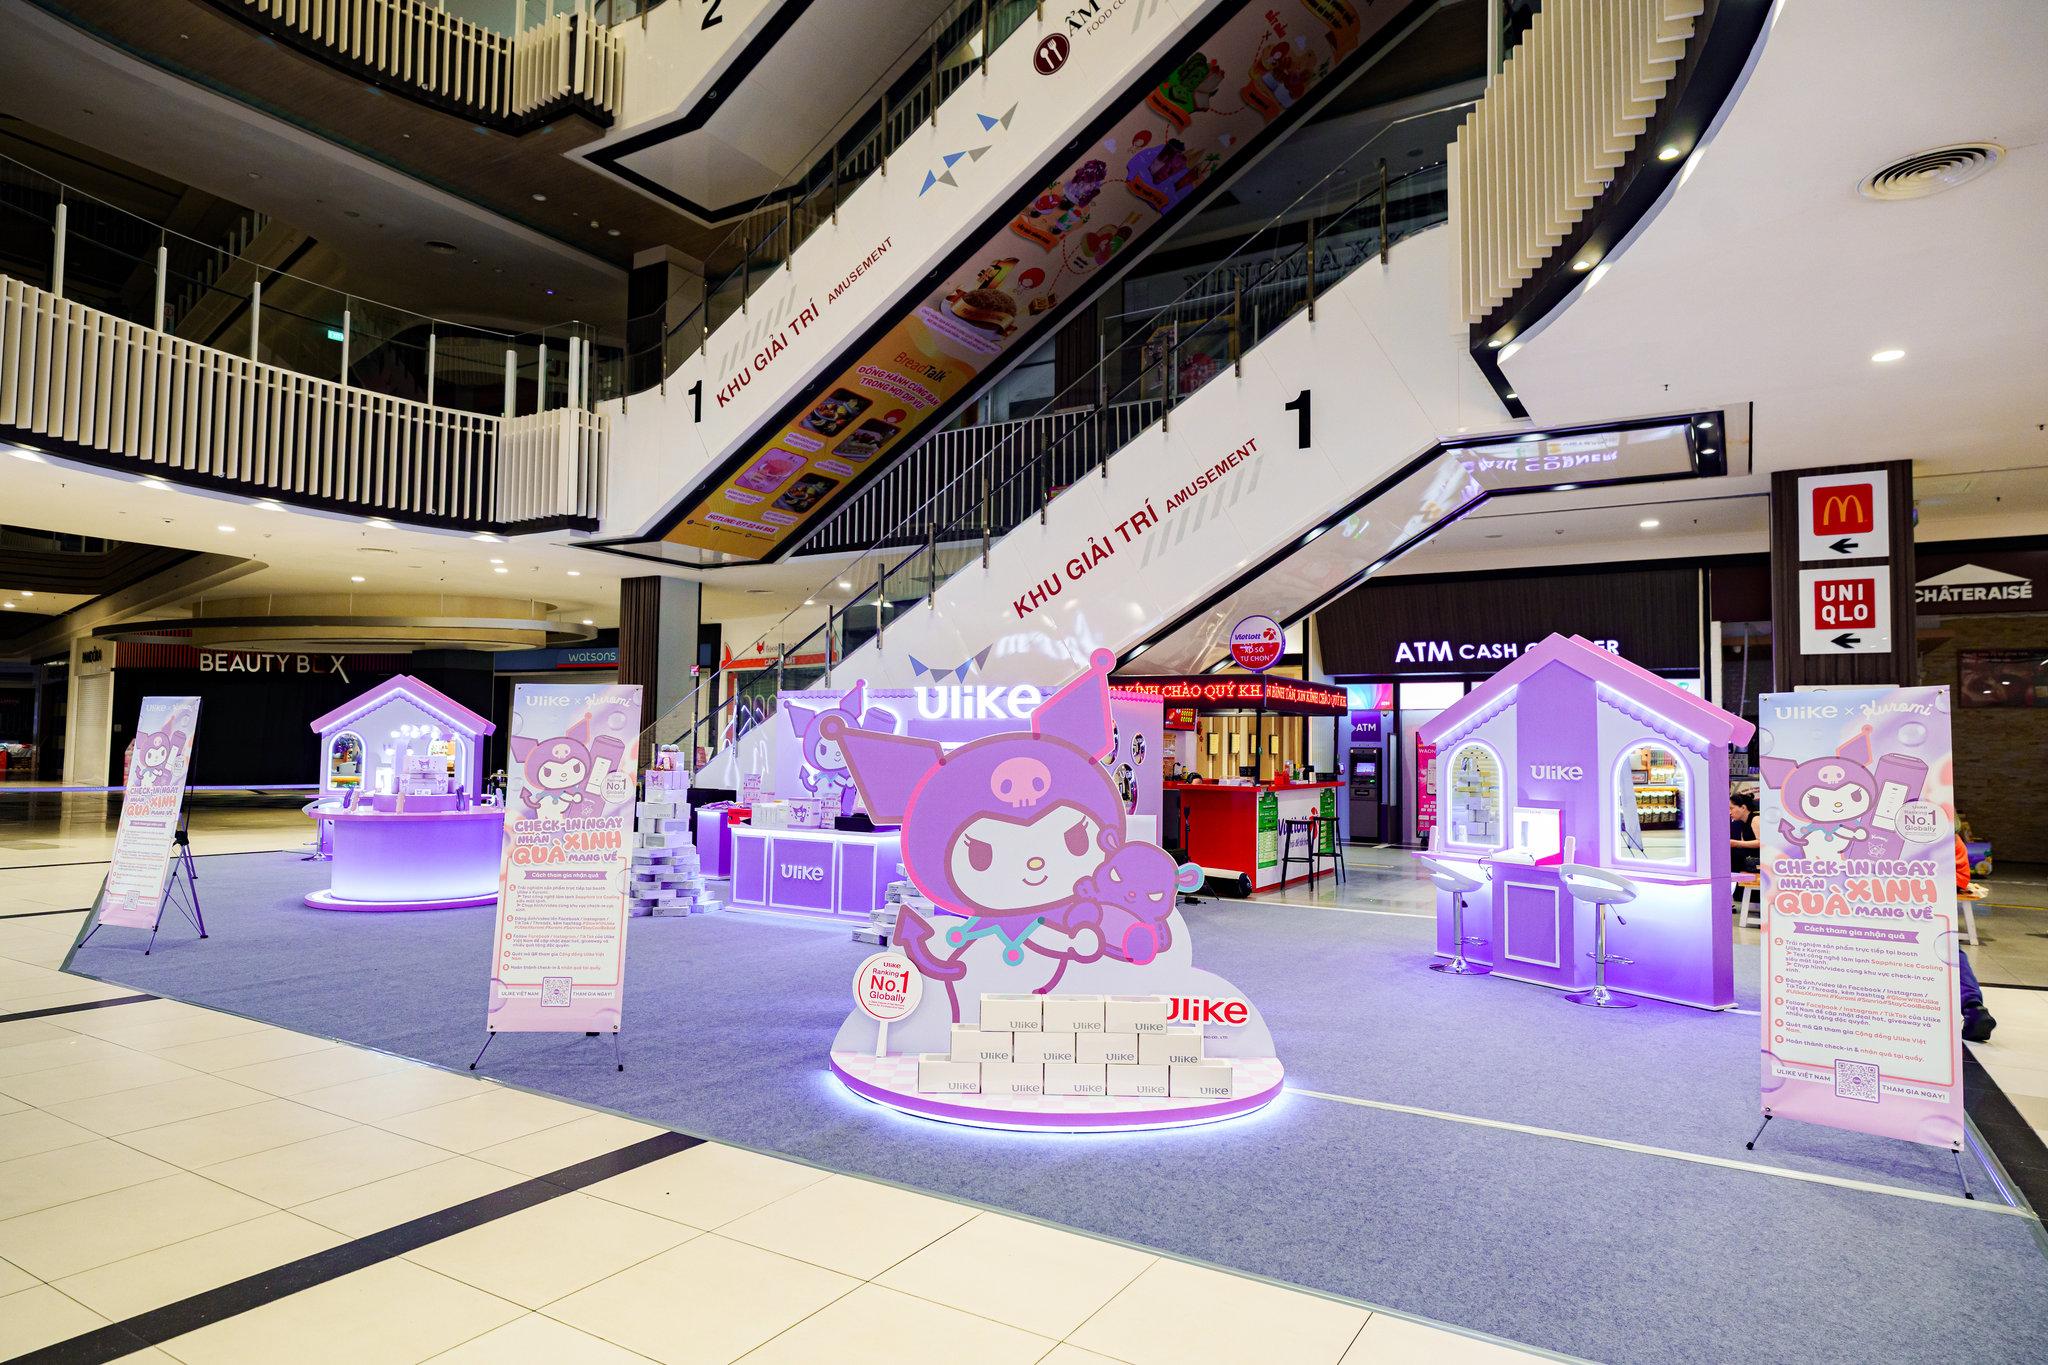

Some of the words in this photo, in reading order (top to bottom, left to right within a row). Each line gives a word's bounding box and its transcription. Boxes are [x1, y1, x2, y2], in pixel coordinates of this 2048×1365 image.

[1087, 9, 1114, 36] FOOD
[716, 367, 751, 408] KHU
[753, 333, 789, 371] GIẢI
[788, 297, 820, 336] TRÍ
[827, 236, 893, 304] AMUSEMENT
[894, 352, 947, 382] BreadTalk
[860, 377, 889, 391] TRONG
[688, 380, 702, 423] 1
[1285, 389, 1311, 450] 1
[1013, 573, 1063, 619] KHU
[1066, 536, 1115, 581] GIẢI
[1114, 498, 1159, 543] TRÍ
[1166, 437, 1260, 513] AMUSEMENT
[1821, 583, 1864, 602] UNI
[1915, 581, 2033, 603] CHÂTERAISÉ
[1821, 604, 1868, 625] QLO
[568, 651, 616, 662] watsons
[1395, 641, 1453, 663] ATM
[1459, 643, 1518, 660] CASH
[200, 653, 290, 672] BEAUTY
[1161, 681, 1202, 699] CHÀO
[1204, 680, 1234, 701] QUÝ
[526, 695, 570, 706] Ulike
[913, 684, 1041, 719] Ulike
[1774, 705, 1838, 720] Ulike
[1356, 723, 1376, 732] ATM
[1530, 765, 1583, 781] Ulike
[514, 819, 582, 832] CHECK-IN
[584, 817, 623, 830] NGAY
[1904, 810, 1937, 826] No.1
[1904, 825, 1937, 833] Globally
[564, 831, 621, 851] XINH
[513, 839, 566, 865] QUÀ
[568, 853, 601, 861] MANG
[780, 863, 824, 881] Ulike
[1775, 860, 1870, 876] CHECK-IN
[1875, 861, 1936, 876] NGAY
[1846, 878, 1937, 903] XINH
[1775, 885, 1851, 916] QUÀ
[1854, 906, 1905, 917] MANG
[1910, 904, 1934, 920] VỀ
[1804, 925, 1825, 934] Cách
[1826, 927, 1848, 936] tham
[1848, 928, 1863, 937] gia
[1864, 930, 1887, 939] nhận
[872, 968, 900, 978] Ranking
[1916, 963, 1943, 971] Cooling
[870, 971, 909, 993] No.1
[1891, 972, 1921, 980] check-in
[869, 990, 906, 1004] Globally
[1848, 984, 1881, 993] Facebook
[1887, 989, 1924, 998] Instagram
[1856, 991, 1885, 999] hashtag
[1806, 1001, 1838, 1010] Facebook
[1010, 1021, 1038, 1030] Ulike
[1072, 1021, 1101, 1030] Ulike
[1135, 1022, 1164, 1031] Ulike
[1824, 1025, 1841, 1033] tham
[1888, 1017, 1921, 1027] giveaway
[1824, 1043, 1853, 1052] check-in
[980, 1052, 1009, 1061] Ulike
[1043, 1052, 1072, 1061] Ulike
[1106, 1053, 1135, 1062] Ulike
[1169, 1055, 1198, 1064] Ulike
[1776, 1068, 1796, 1077] ULIKE
[1797, 1070, 1813, 1079] VIỆT
[1814, 1074, 1831, 1082] NAM
[948, 1082, 977, 1091] Ulike
[1011, 1084, 1040, 1093] Ulike
[1074, 1084, 1102, 1093] Ulike
[1136, 1085, 1165, 1094] Ulike
[1200, 1087, 1229, 1096] Ulike
[1882, 1085, 1904, 1093] THAM
[1905, 1087, 1920, 1096] GIA
[1920, 1090, 1946, 1100] NGAY!
